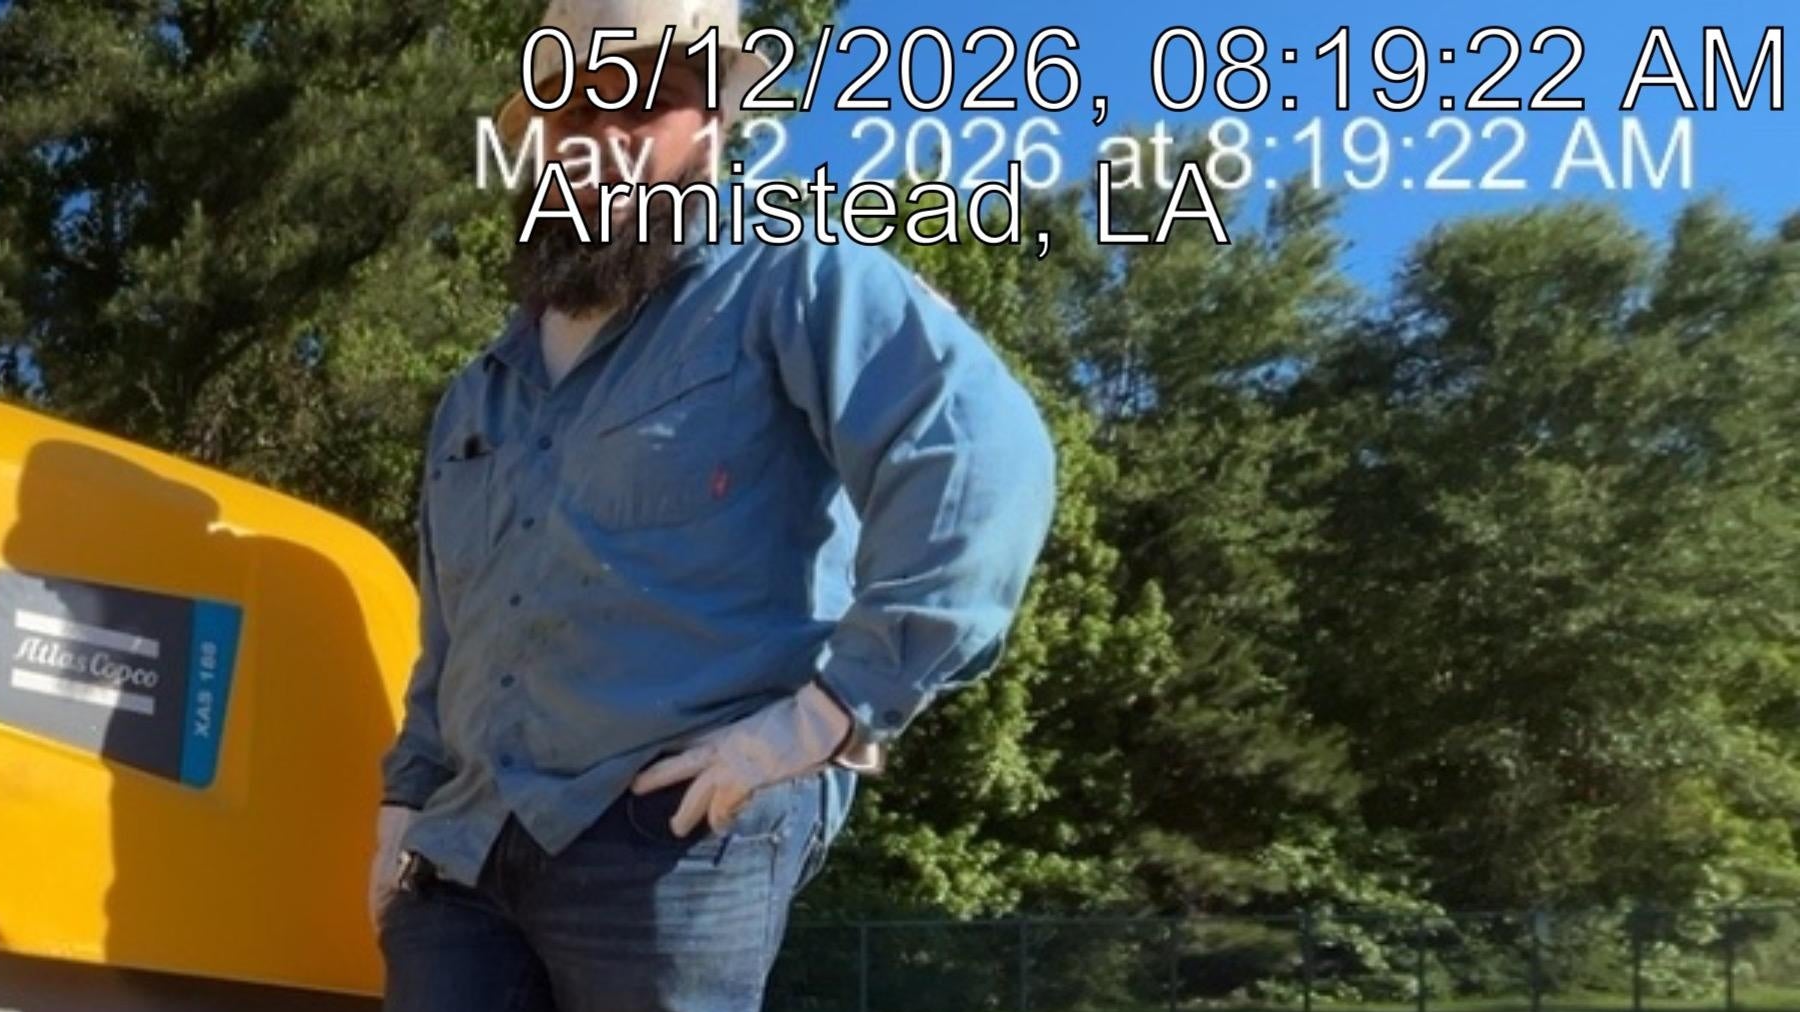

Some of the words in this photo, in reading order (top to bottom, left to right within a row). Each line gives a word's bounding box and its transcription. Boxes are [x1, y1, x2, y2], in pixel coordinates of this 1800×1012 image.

[13, 636, 87, 673] Atlas
[89, 651, 159, 688] Copco
[194, 691, 215, 738] XAS
